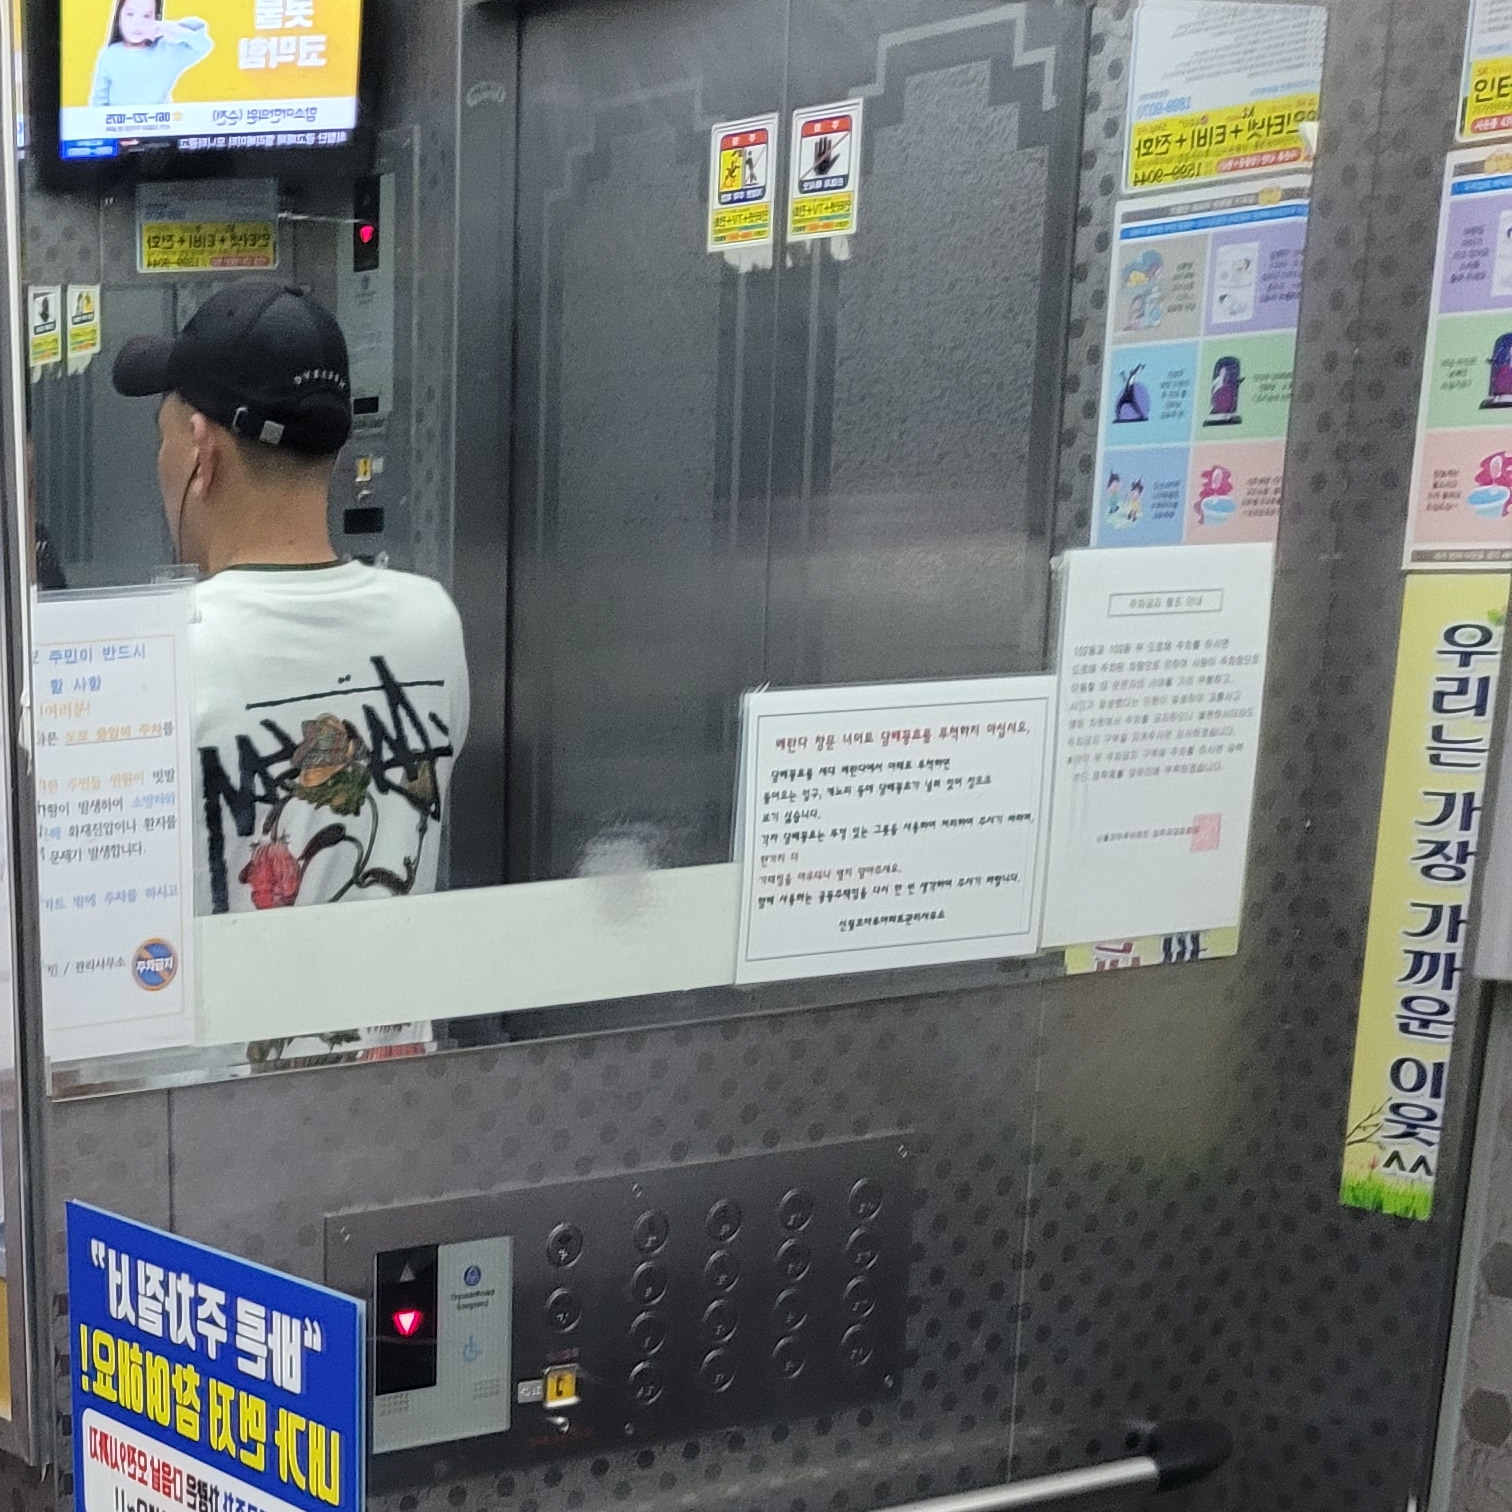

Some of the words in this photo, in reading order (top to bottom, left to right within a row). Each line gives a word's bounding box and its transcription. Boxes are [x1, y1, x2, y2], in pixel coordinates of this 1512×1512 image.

[49, 649, 94, 664] 주민이
[102, 644, 146, 661] 반드시
[49, 677, 64, 695] 할
[72, 675, 102, 693] 사항
[1422, 622, 1504, 770] 우리는
[1407, 788, 1484, 886] 가장
[1388, 899, 1471, 1041] 가까운
[1381, 1053, 1448, 1149] 이웃
